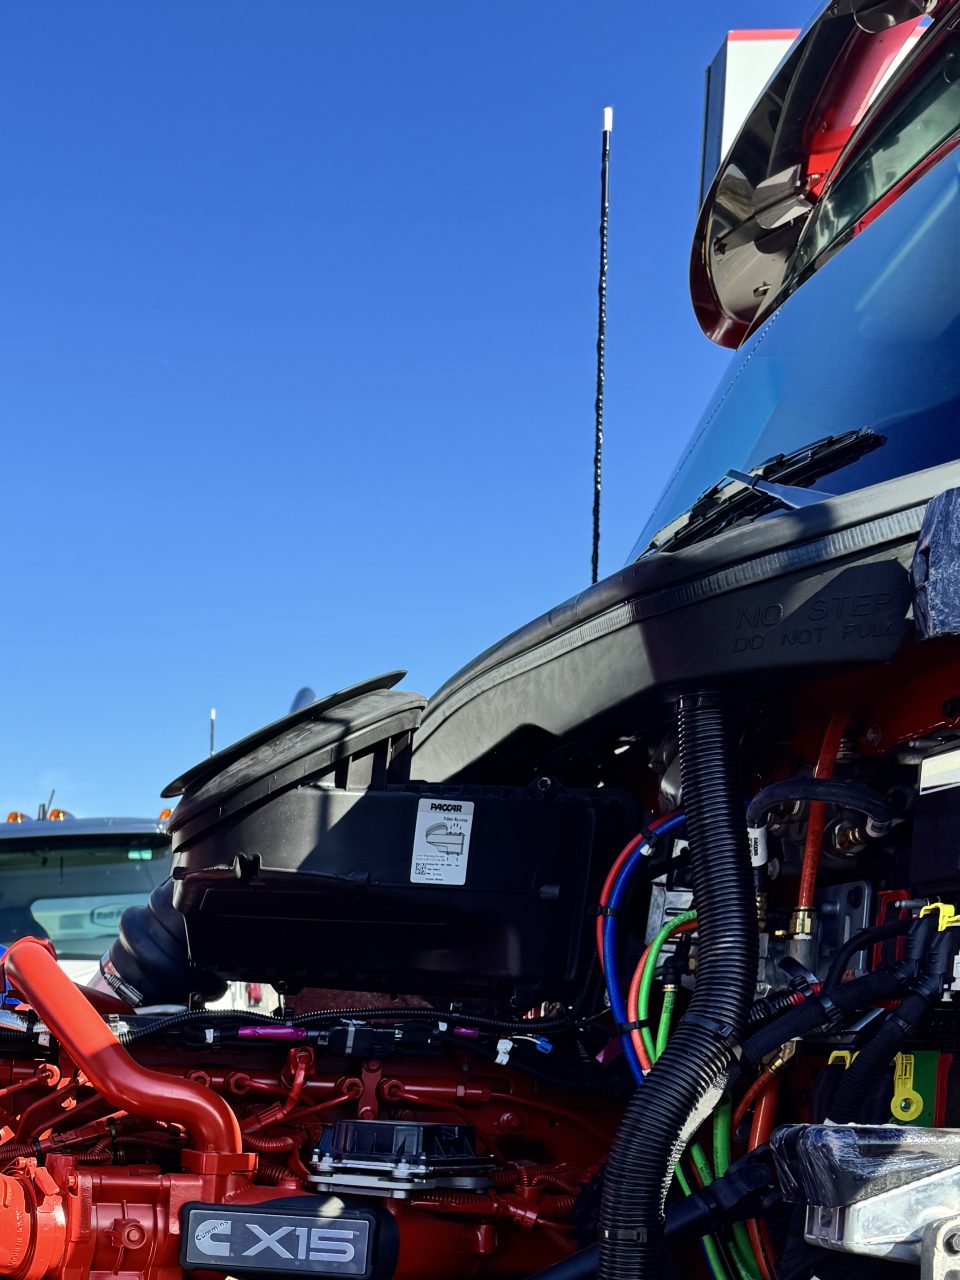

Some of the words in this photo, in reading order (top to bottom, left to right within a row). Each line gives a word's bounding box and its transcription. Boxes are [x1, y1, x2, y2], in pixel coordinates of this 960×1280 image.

[735, 603, 784, 631] NO
[808, 592, 894, 622] STEP
[733, 633, 766, 653] DO
[780, 627, 826, 647] NOT
[430, 802, 464, 813] PACCAR
[195, 1219, 231, 1241] Cummins
[241, 1223, 355, 1263] X15
